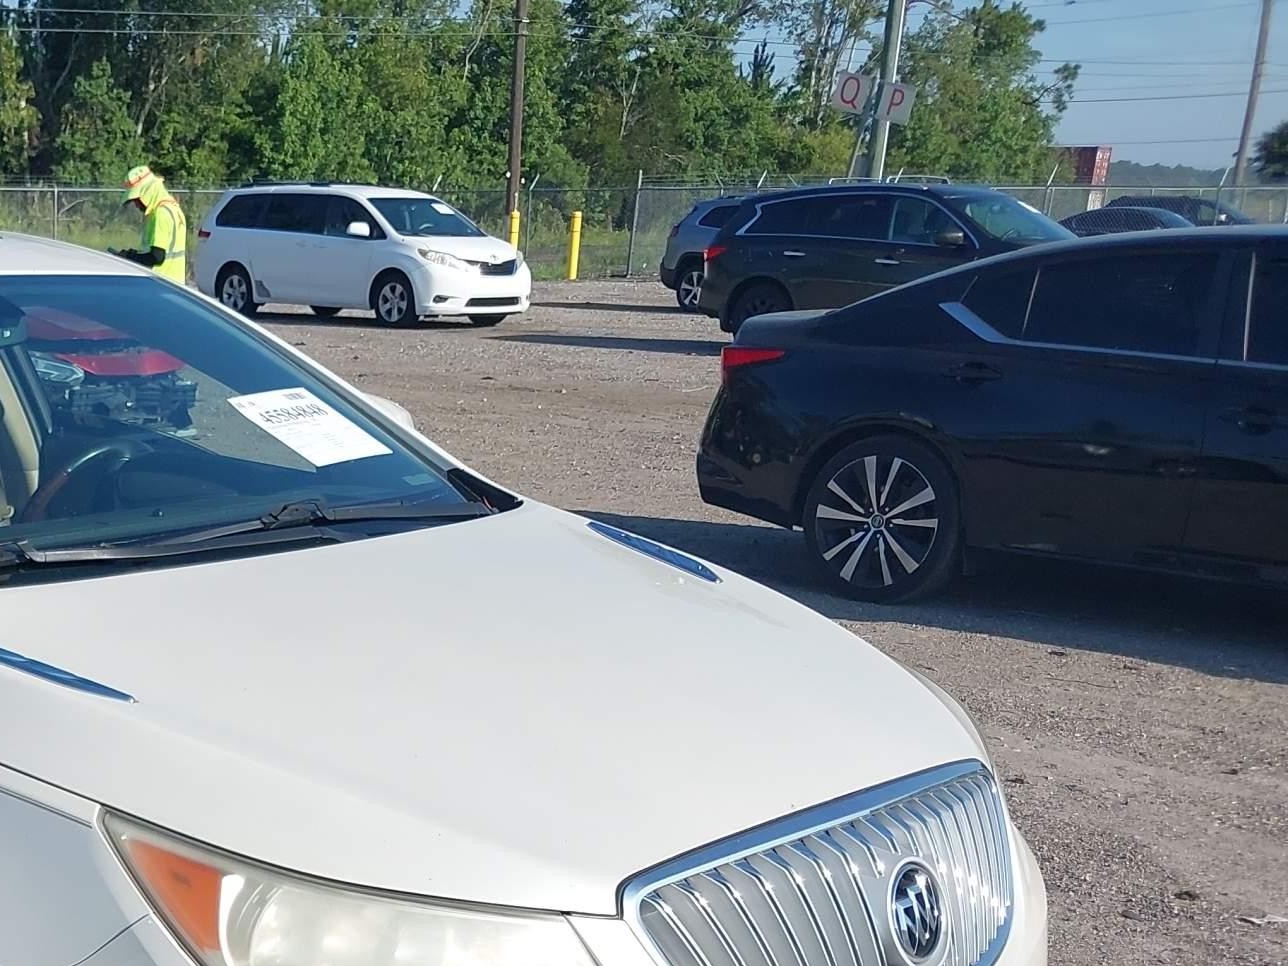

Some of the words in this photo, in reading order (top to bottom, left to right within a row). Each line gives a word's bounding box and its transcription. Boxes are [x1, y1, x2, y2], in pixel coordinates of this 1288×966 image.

[840, 76, 860, 109] Q
[886, 88, 905, 115] P
[259, 404, 329, 424] 45584848
